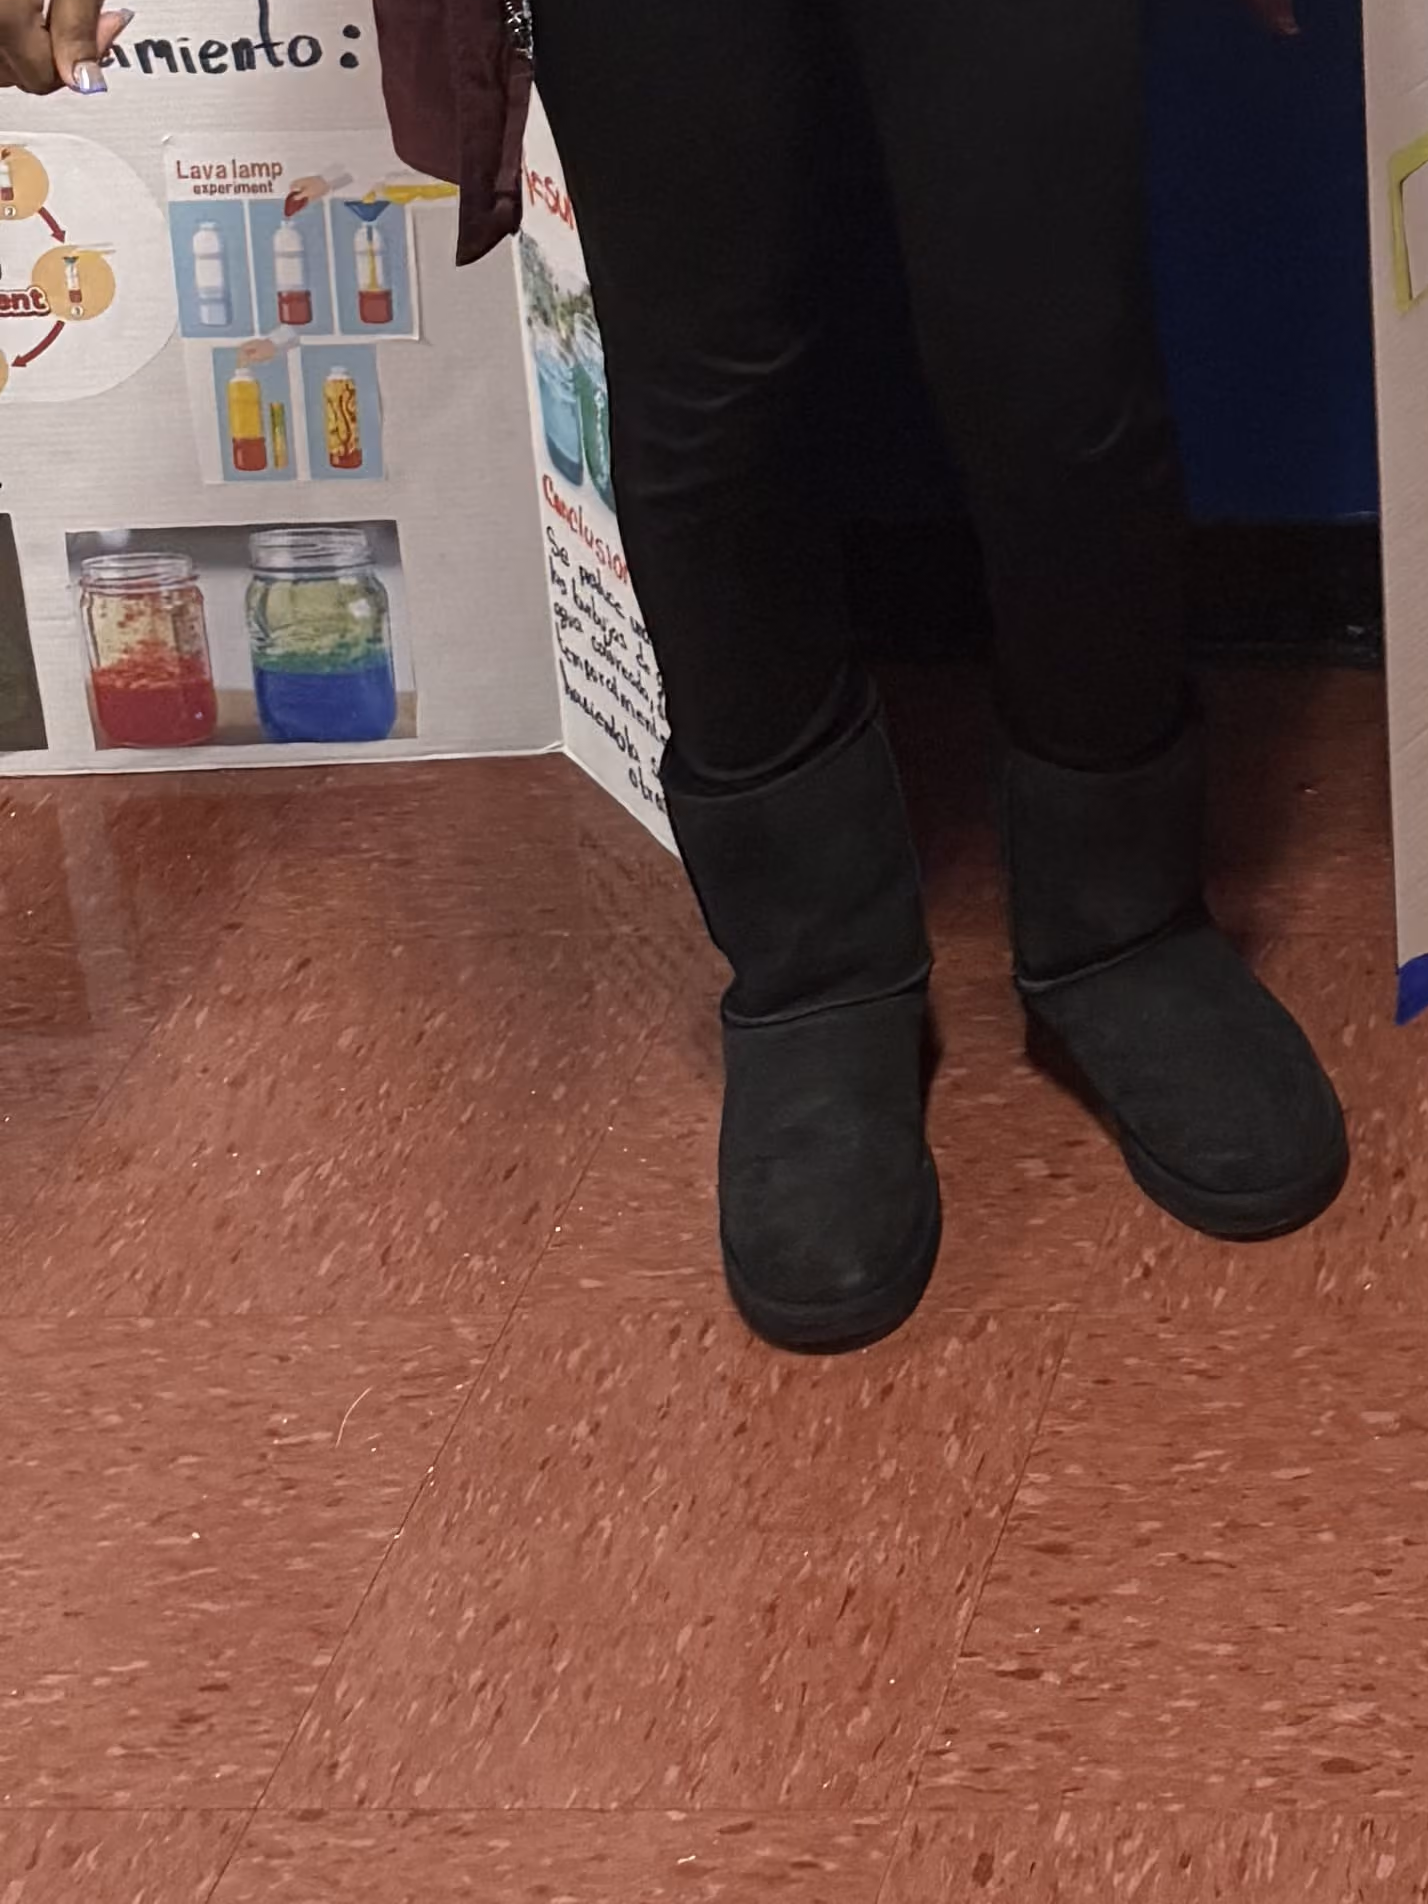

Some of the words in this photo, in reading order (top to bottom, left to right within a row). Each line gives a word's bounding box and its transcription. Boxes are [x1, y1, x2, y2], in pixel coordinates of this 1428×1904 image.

[175, 159, 228, 180] Lava
[232, 158, 283, 184] lamp
[193, 180, 274, 195] experiment
